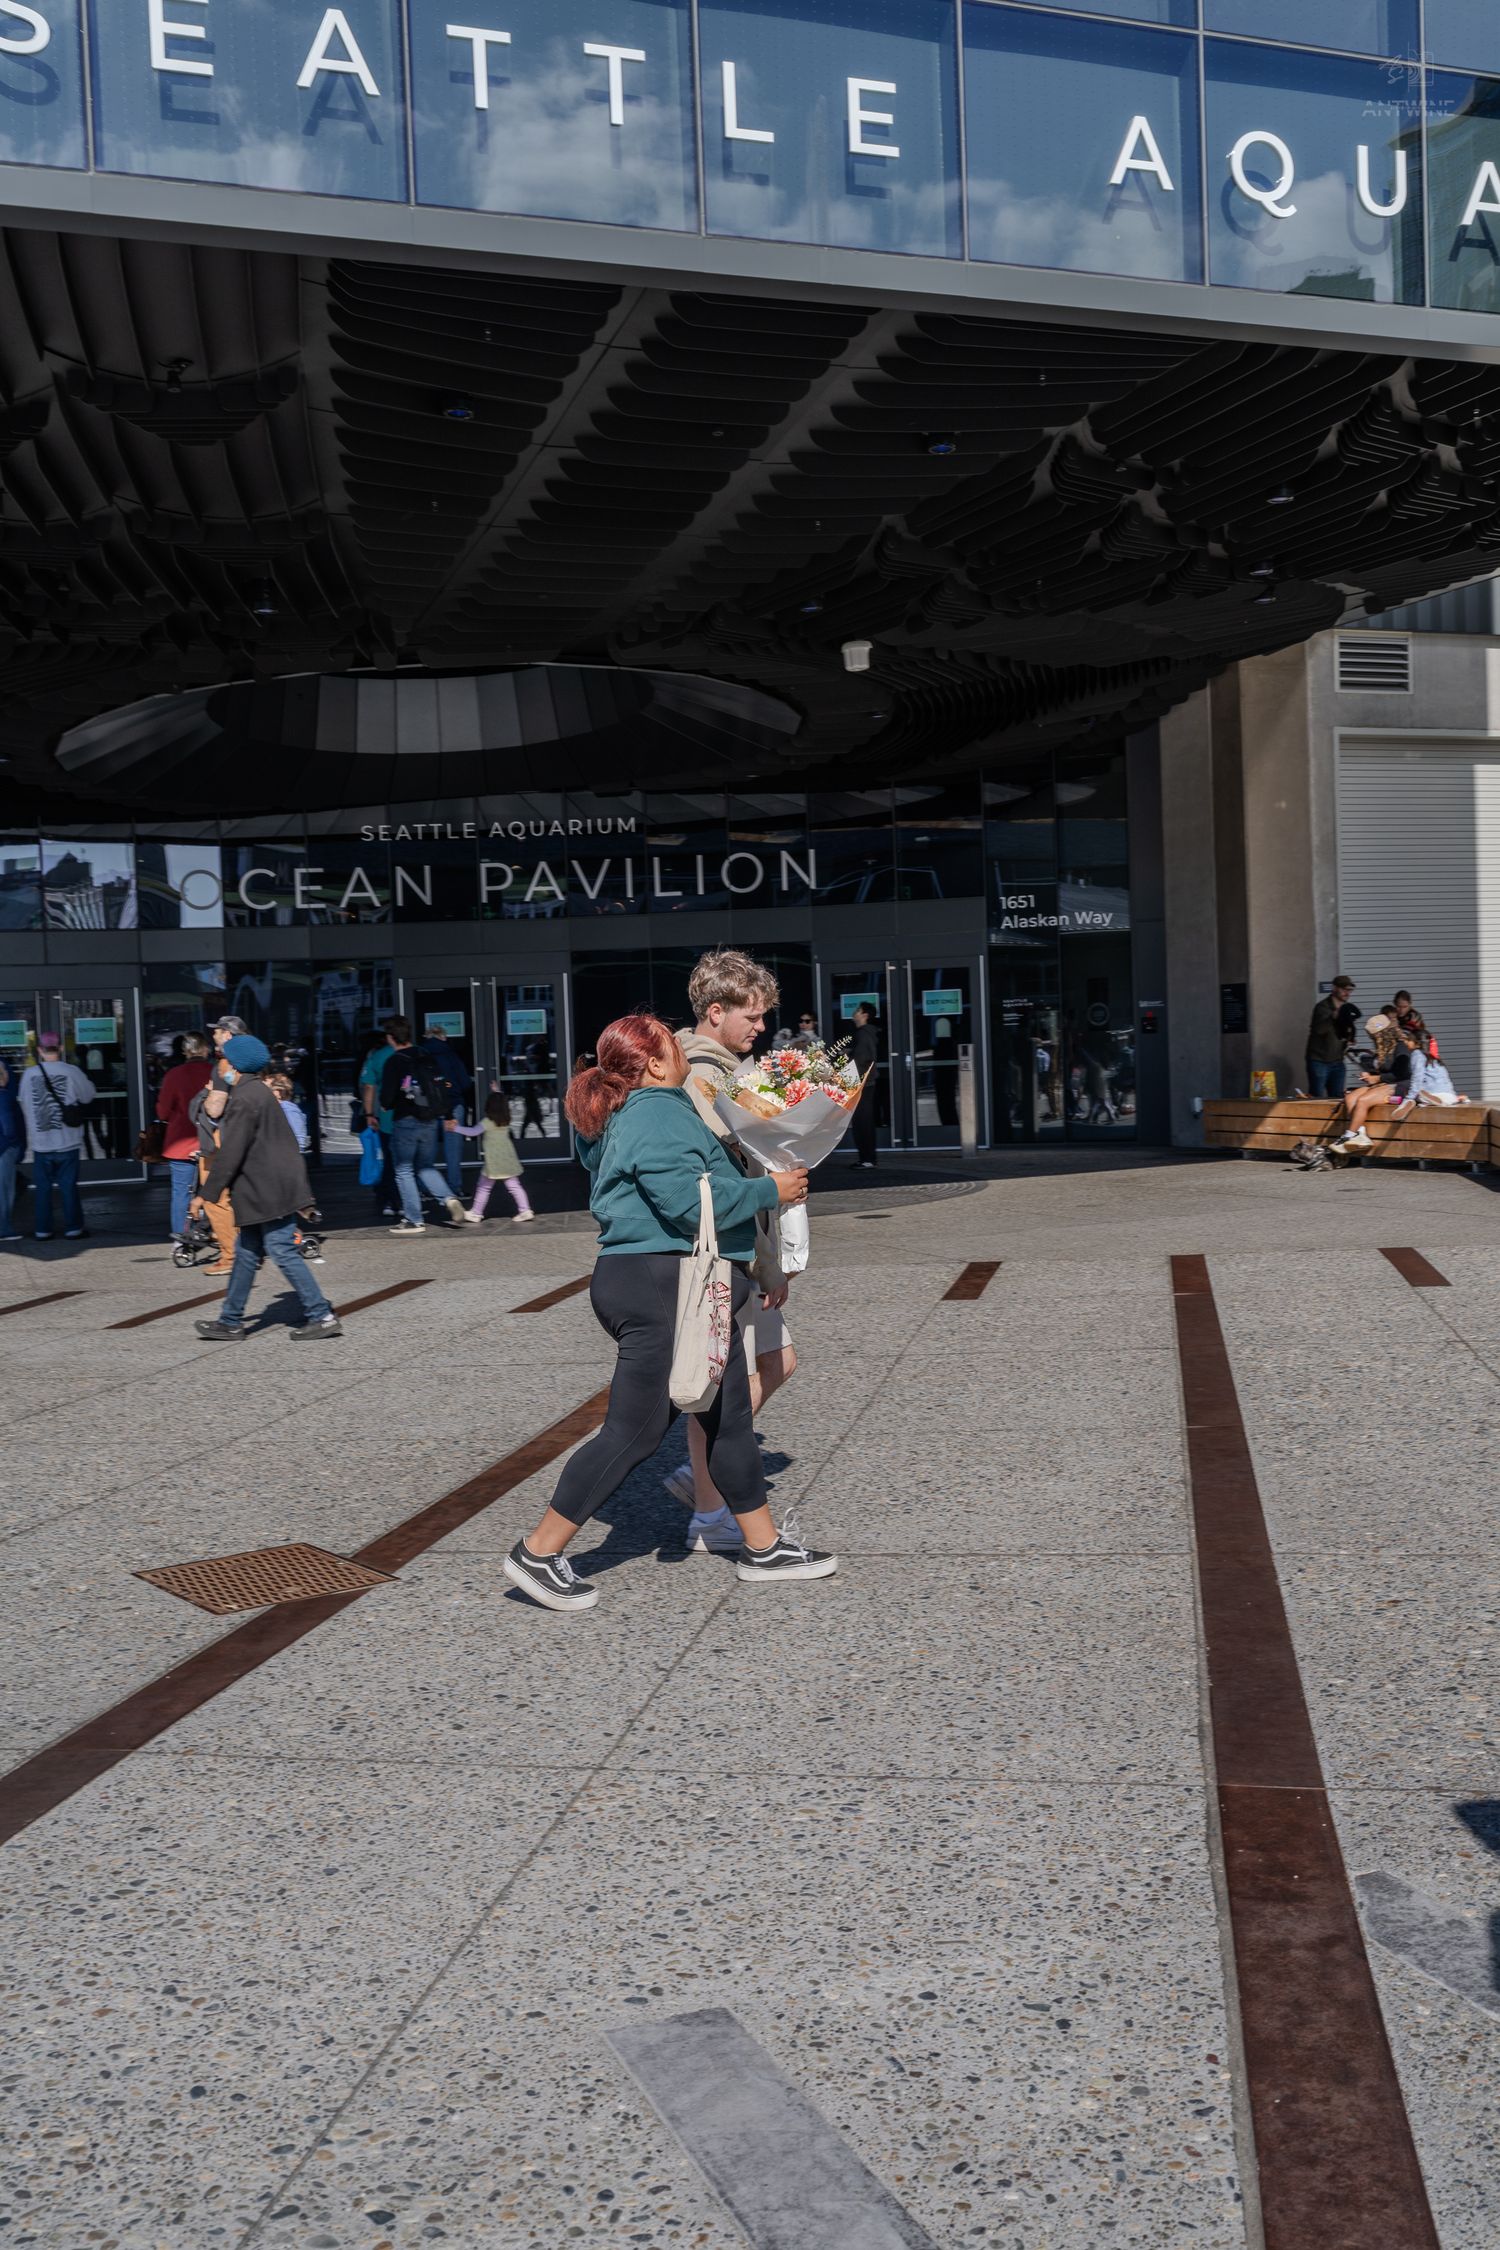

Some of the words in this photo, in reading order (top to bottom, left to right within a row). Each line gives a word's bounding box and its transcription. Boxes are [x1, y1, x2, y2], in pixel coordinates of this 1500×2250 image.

[360, 822, 477, 842] SEATTLE
[488, 816, 637, 840] AQUARIUM
[179, 864, 433, 910] OCEAN
[479, 849, 818, 904] PAVILION
[999, 894, 1036, 910] 1651
[1000, 913, 1070, 930] Alaskan
[1074, 910, 1114, 927] Way
